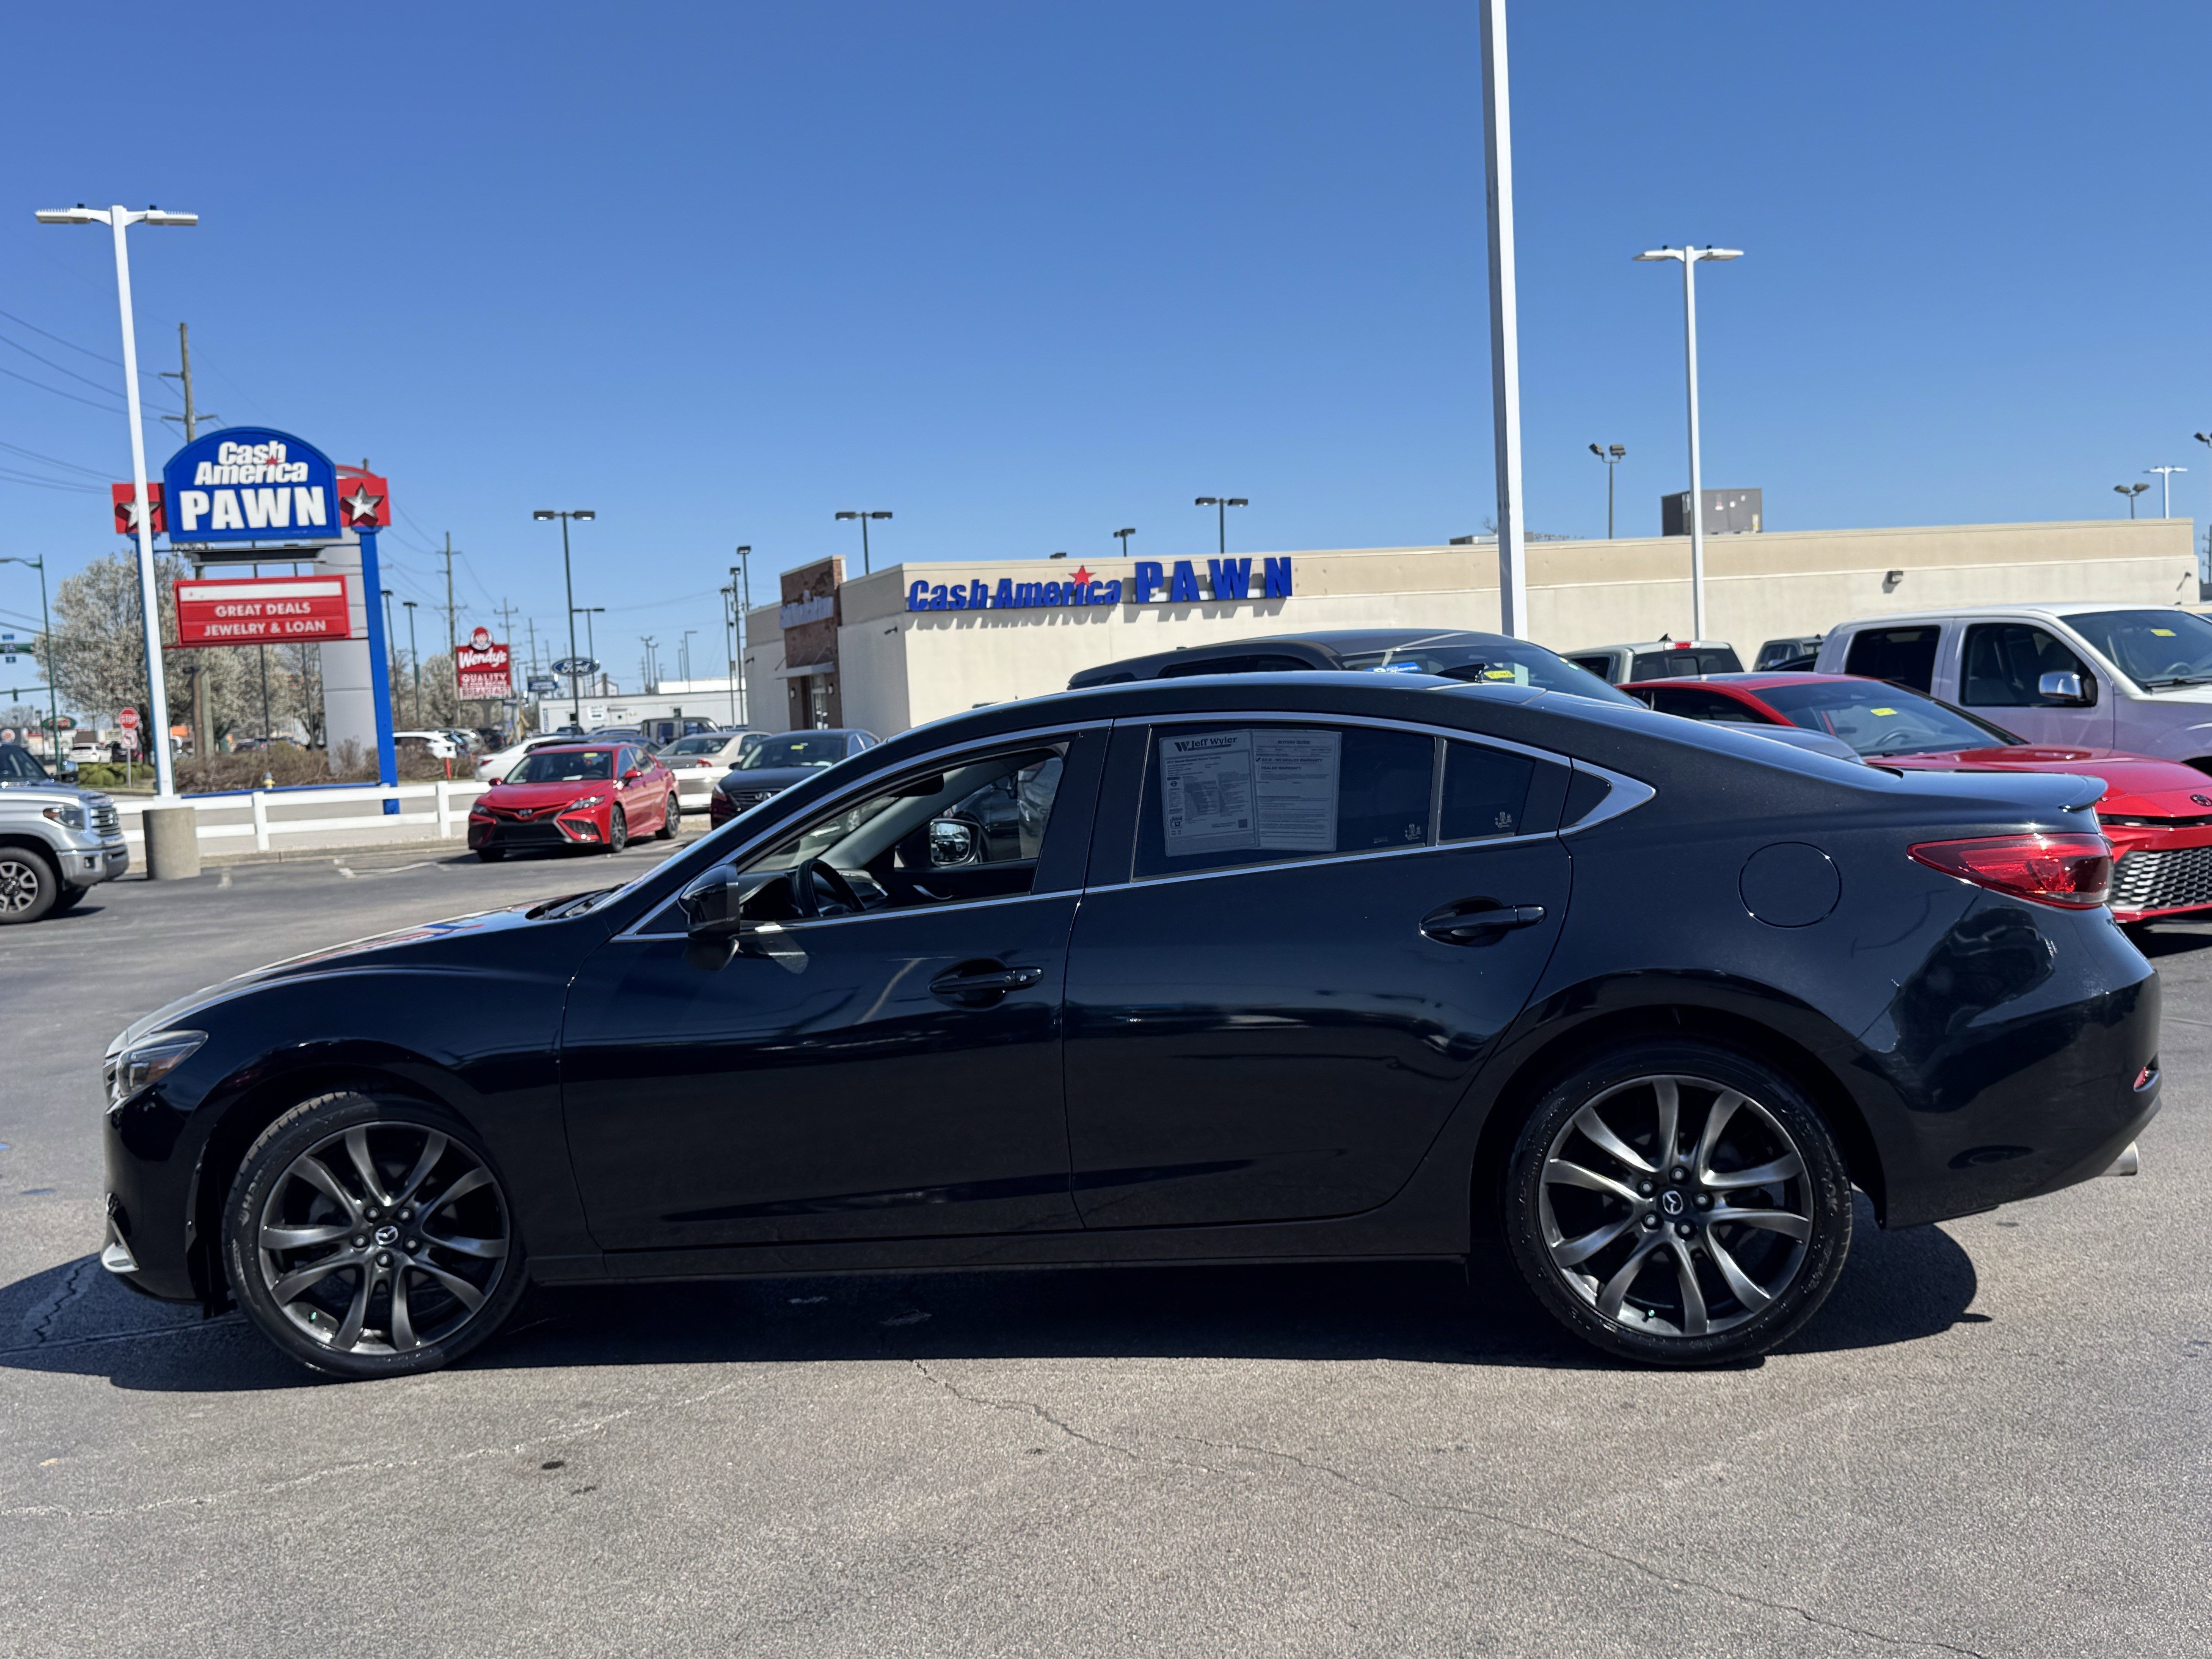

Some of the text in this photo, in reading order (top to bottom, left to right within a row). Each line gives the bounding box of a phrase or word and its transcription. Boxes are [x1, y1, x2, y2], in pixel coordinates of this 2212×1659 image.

[218, 440, 287, 465] Cash
[194, 461, 308, 486] America
[179, 486, 327, 531] PAWN
[909, 557, 1292, 611] Cash America PAWN
[215, 601, 311, 617] GREAT DEALS
[203, 620, 326, 637] JEWELRY & LOAN
[458, 647, 507, 669] Wendy's
[461, 673, 507, 683] QUALITY
[120, 714, 138, 724] STOP
[1192, 738, 1208, 748] Jeff
[1210, 737, 1237, 745] Wyler
